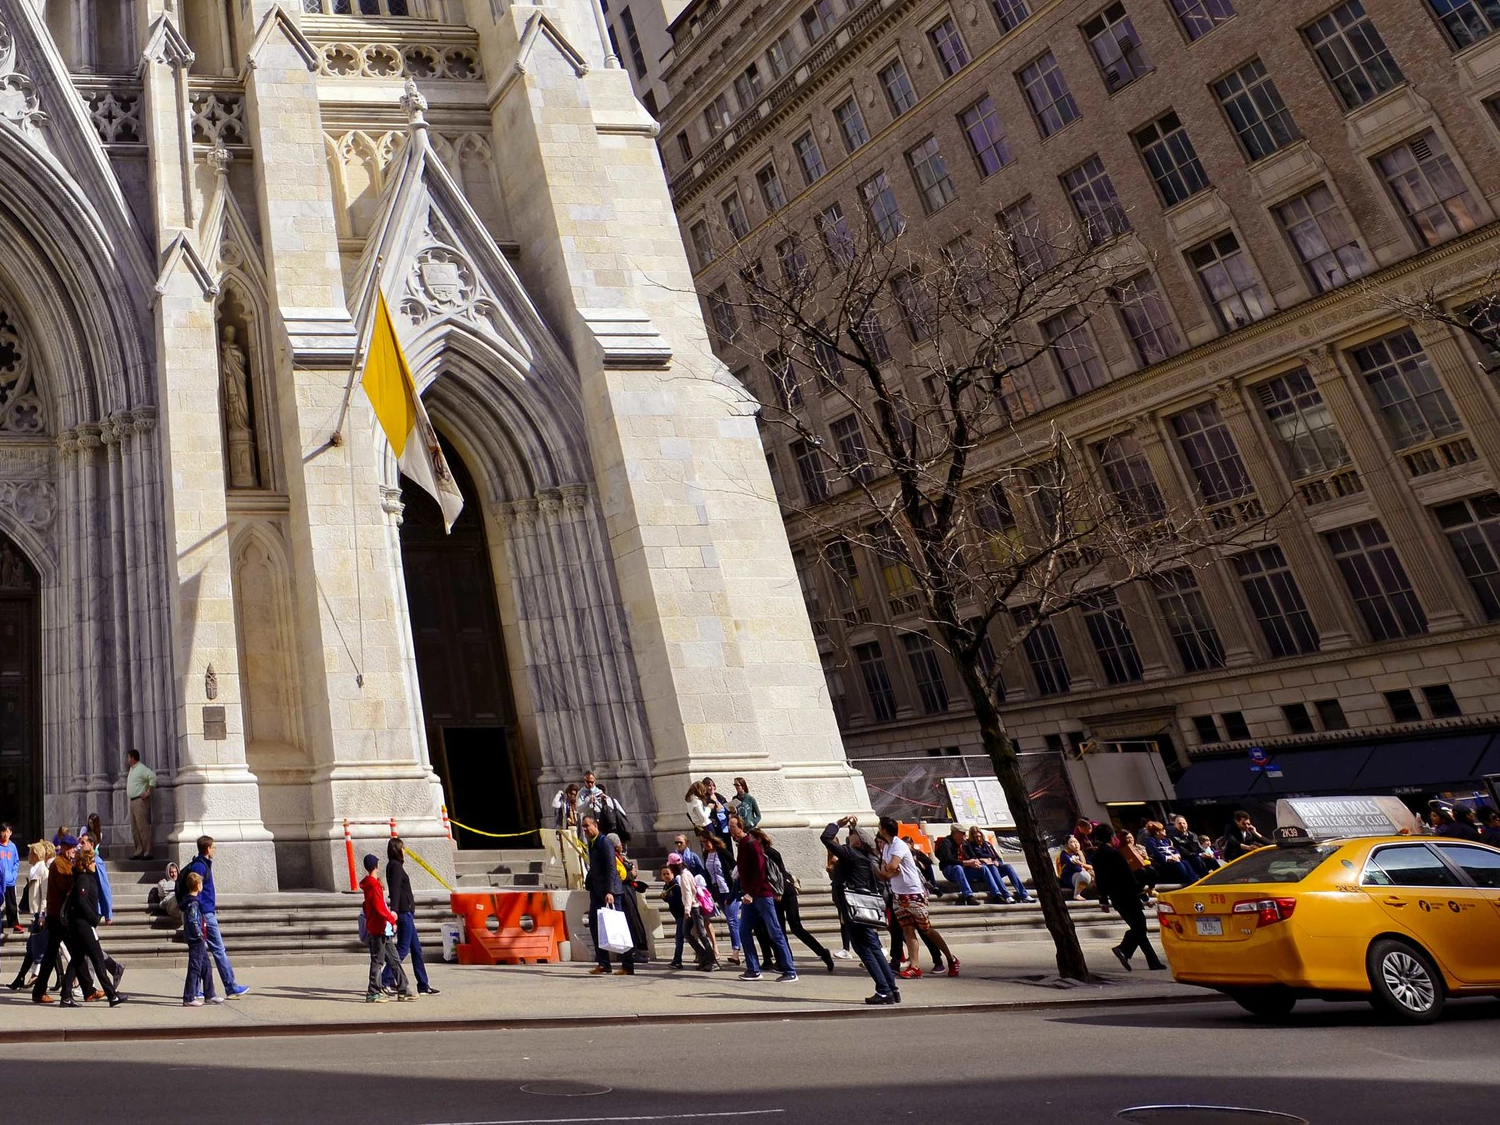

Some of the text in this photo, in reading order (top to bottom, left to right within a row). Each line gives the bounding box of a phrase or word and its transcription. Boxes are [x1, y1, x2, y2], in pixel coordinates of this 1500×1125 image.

[1291, 800, 1380, 817] NEW YORK DOLLS
[1304, 815, 1390, 827] GENTLEMEN'S CLUB
[1281, 828, 1298, 838] 2K39
